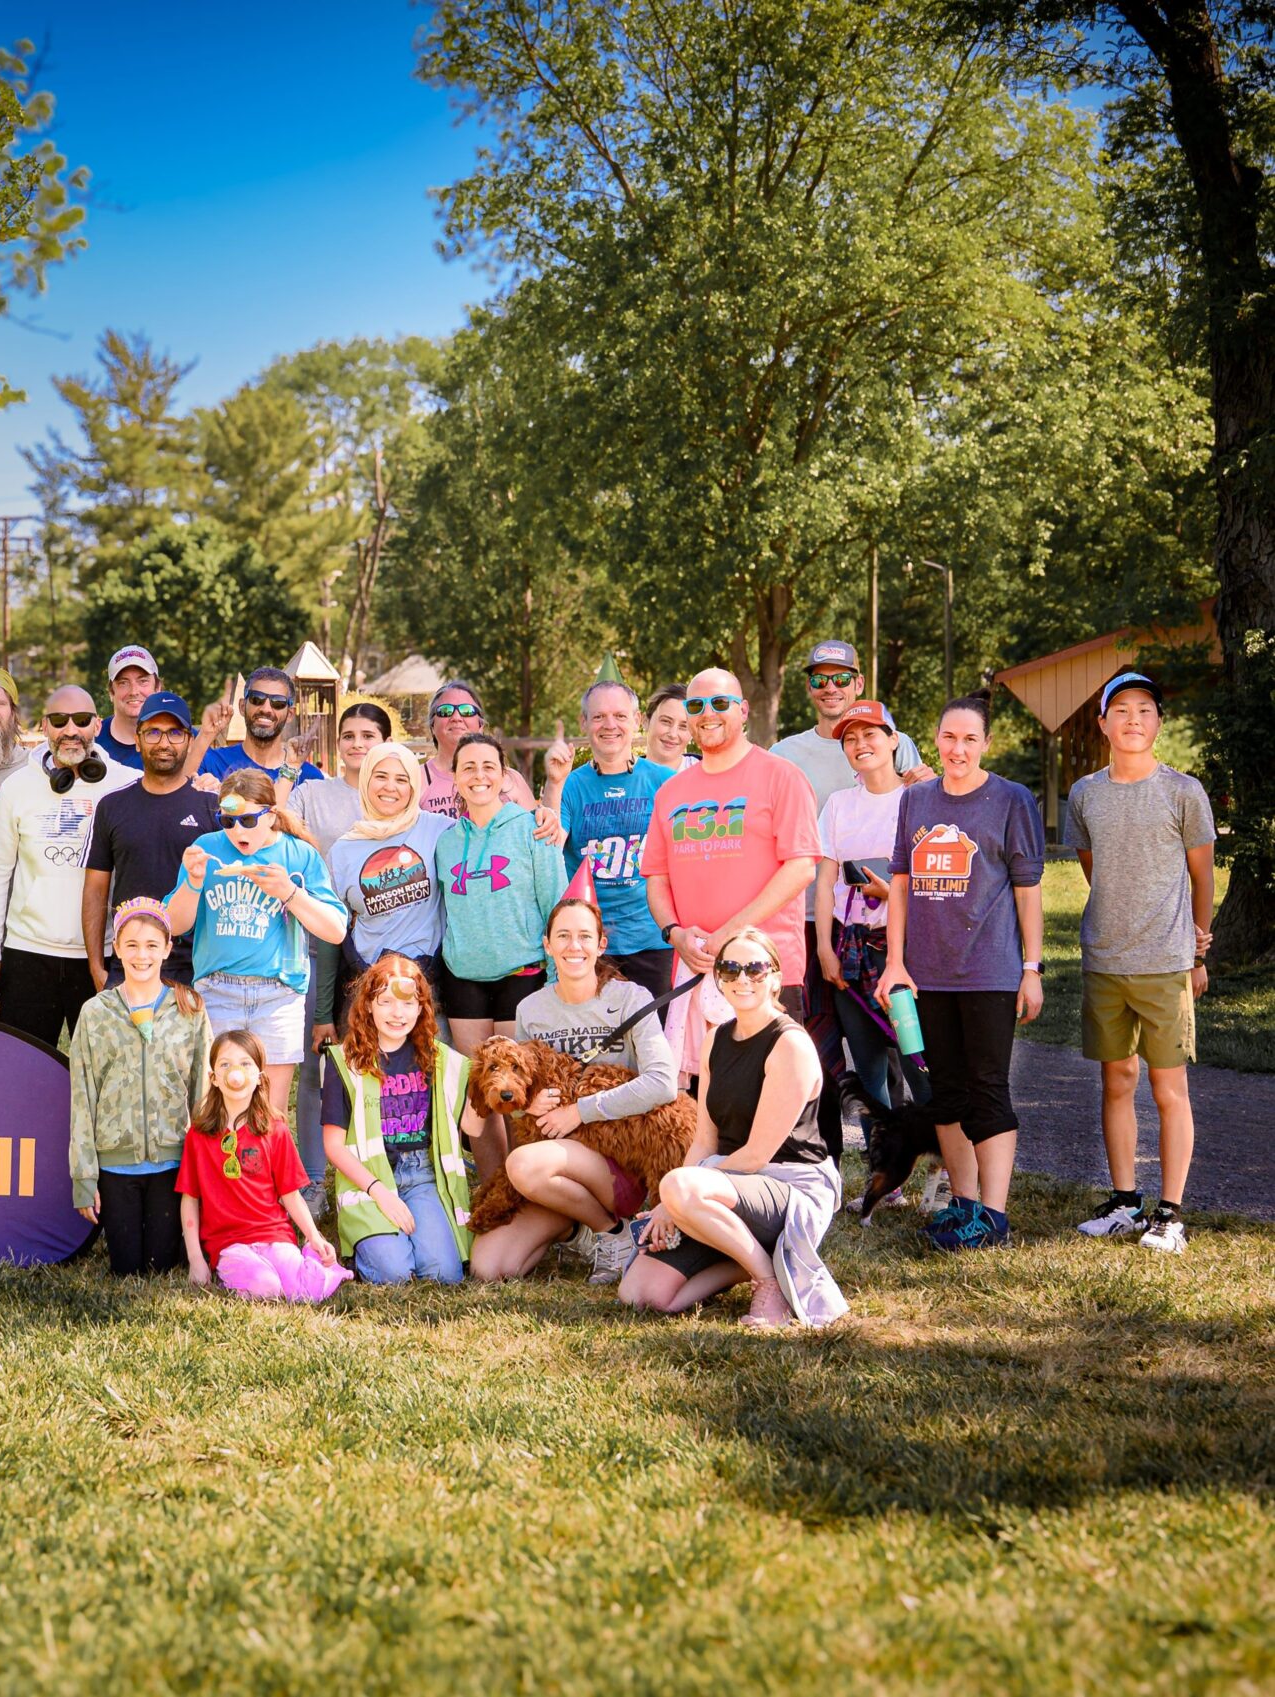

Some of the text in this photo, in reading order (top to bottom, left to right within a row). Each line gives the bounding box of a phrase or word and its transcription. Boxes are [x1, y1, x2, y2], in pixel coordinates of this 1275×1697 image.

[583, 798, 650, 817] MONUMENT
[668, 796, 748, 842] 13.1
[912, 825, 928, 845] THE
[673, 843, 696, 854] PARK
[714, 838, 742, 850] PARK
[926, 854, 952, 871] PIE
[366, 880, 430, 905] JACKSON RIVER
[912, 878, 969, 892] IS THE LIMIT
[206, 881, 282, 918] GROWLER
[368, 887, 430, 915] MARATHON
[216, 923, 266, 942] TEAM RELAY
[533, 1026, 621, 1041] JAMES MADISO
[547, 1035, 625, 1055] UKES
